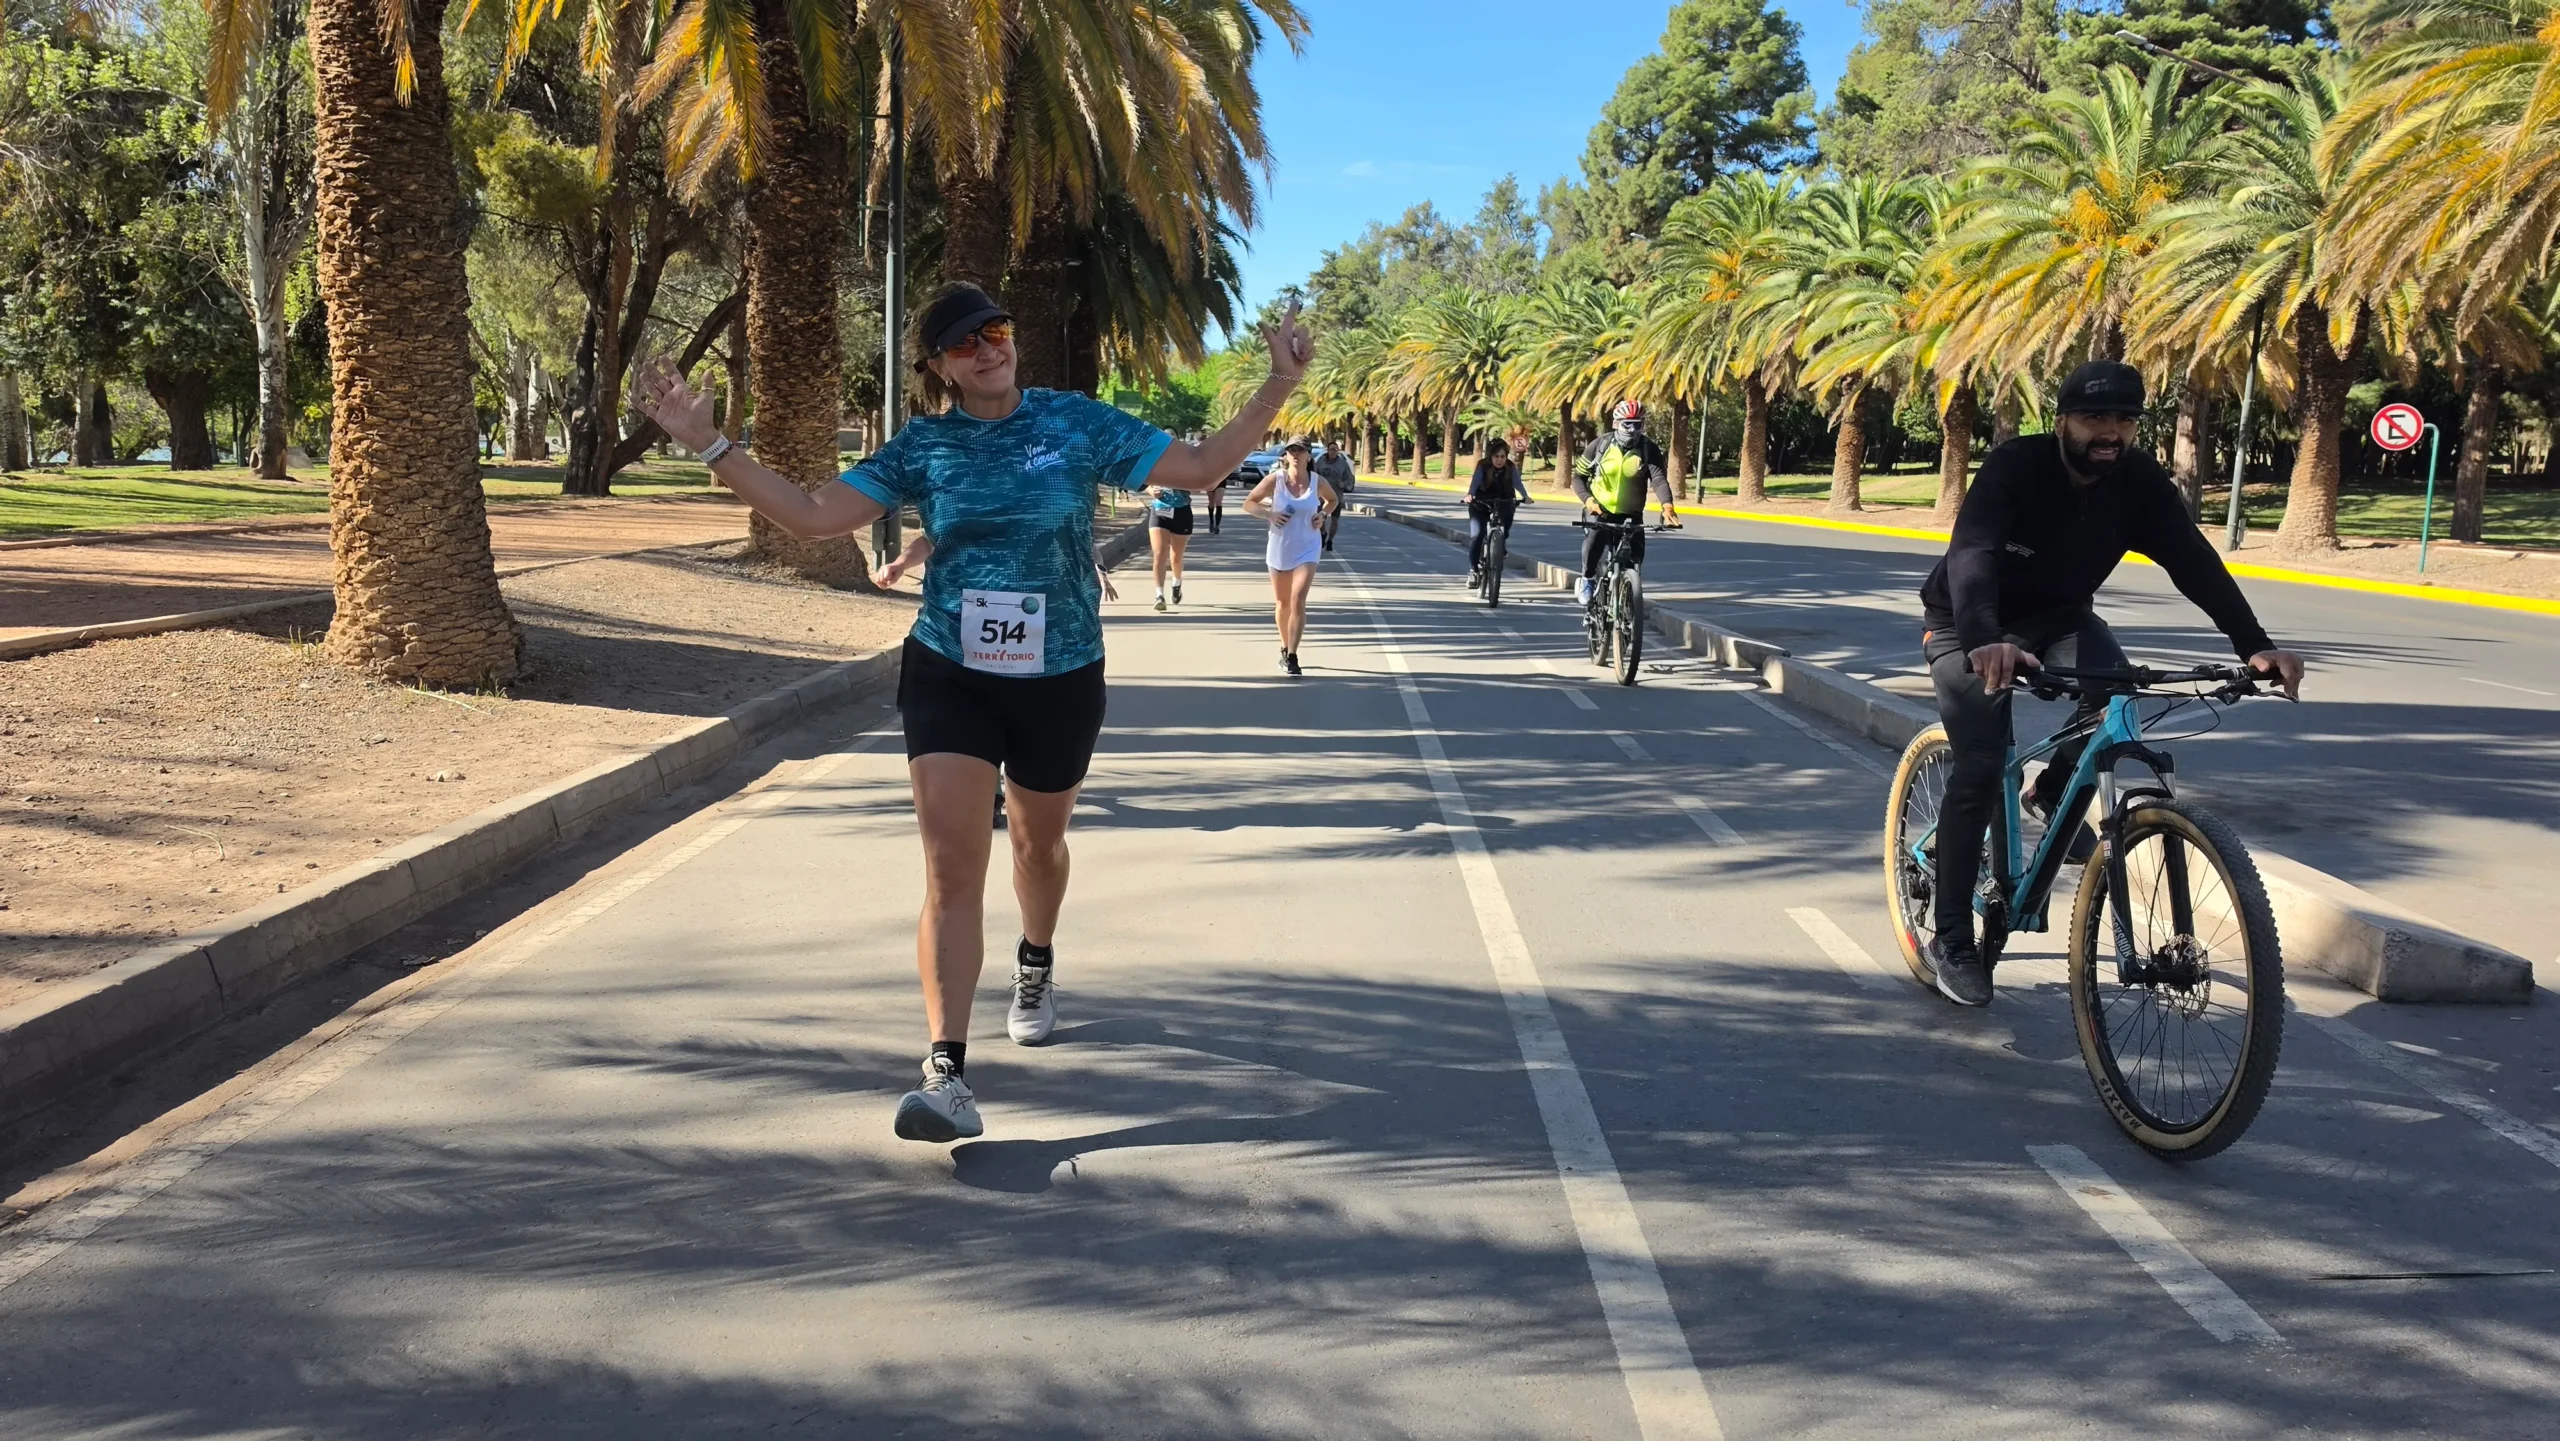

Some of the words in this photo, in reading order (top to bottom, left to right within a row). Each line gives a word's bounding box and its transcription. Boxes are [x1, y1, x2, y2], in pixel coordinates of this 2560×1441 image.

[2388, 413, 2407, 440] E
[979, 619, 1026, 645] 514
[973, 649, 1035, 661] TERRITORIO
[1906, 735, 1932, 764] MAXXIS
[2100, 1077, 2143, 1129] MAXXIS
